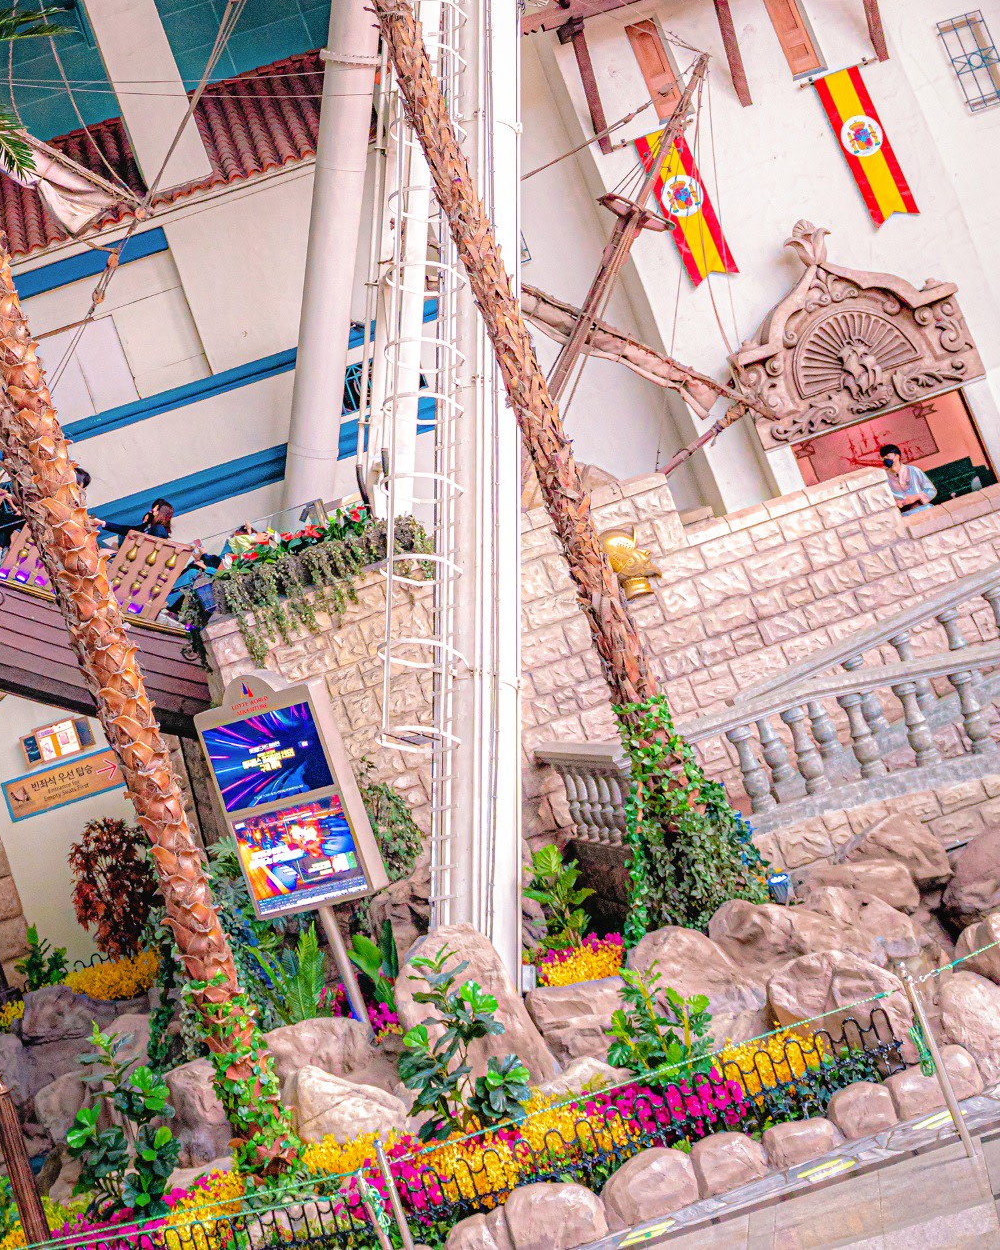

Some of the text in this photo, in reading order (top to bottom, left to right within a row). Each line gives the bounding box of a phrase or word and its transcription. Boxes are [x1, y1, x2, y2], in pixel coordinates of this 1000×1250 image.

[231, 695, 269, 711] LOTTE WORLD
[31, 765, 92, 791] 빈좌석 우선 탑승
[44, 793, 61, 801] Empty
